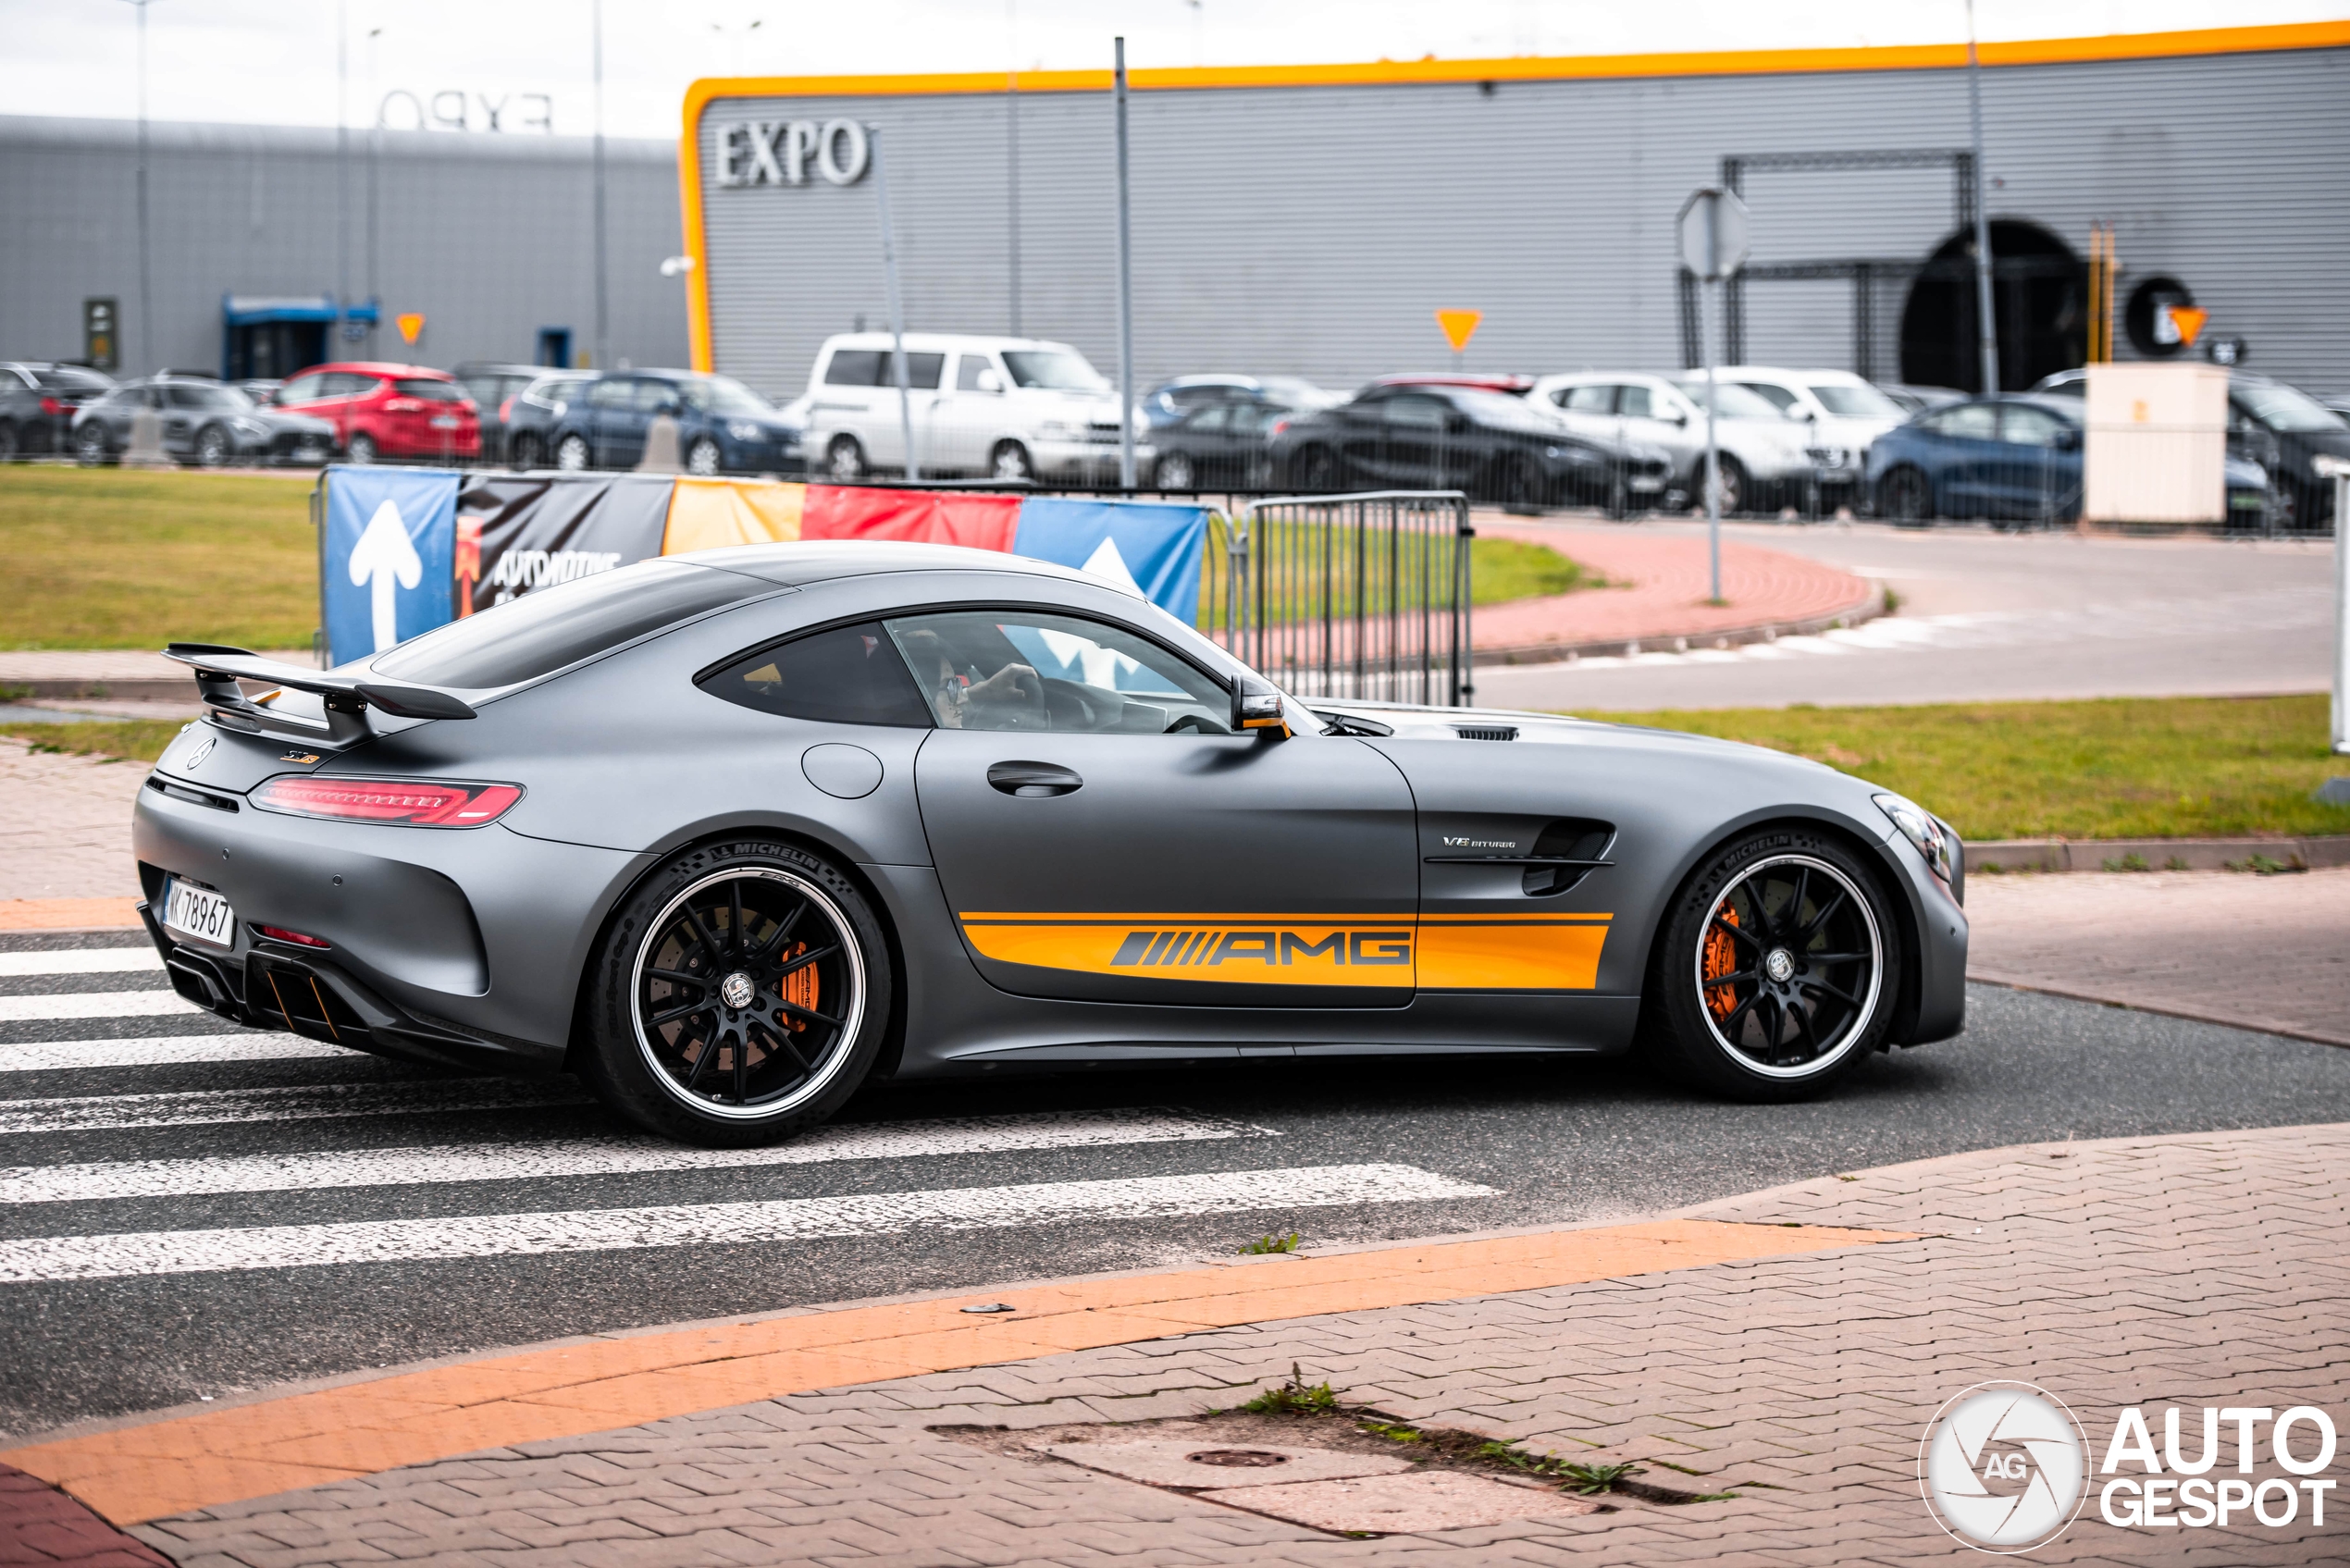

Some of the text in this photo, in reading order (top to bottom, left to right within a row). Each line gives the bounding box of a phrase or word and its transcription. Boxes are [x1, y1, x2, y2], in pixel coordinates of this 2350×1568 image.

[716, 117, 868, 185] EXPO
[734, 843, 820, 868] MICHELIN
[1443, 836, 1470, 846] V8
[1724, 834, 1789, 869] MICHELIN
[183, 891, 229, 937] 78967
[1207, 932, 1410, 965] AMG
